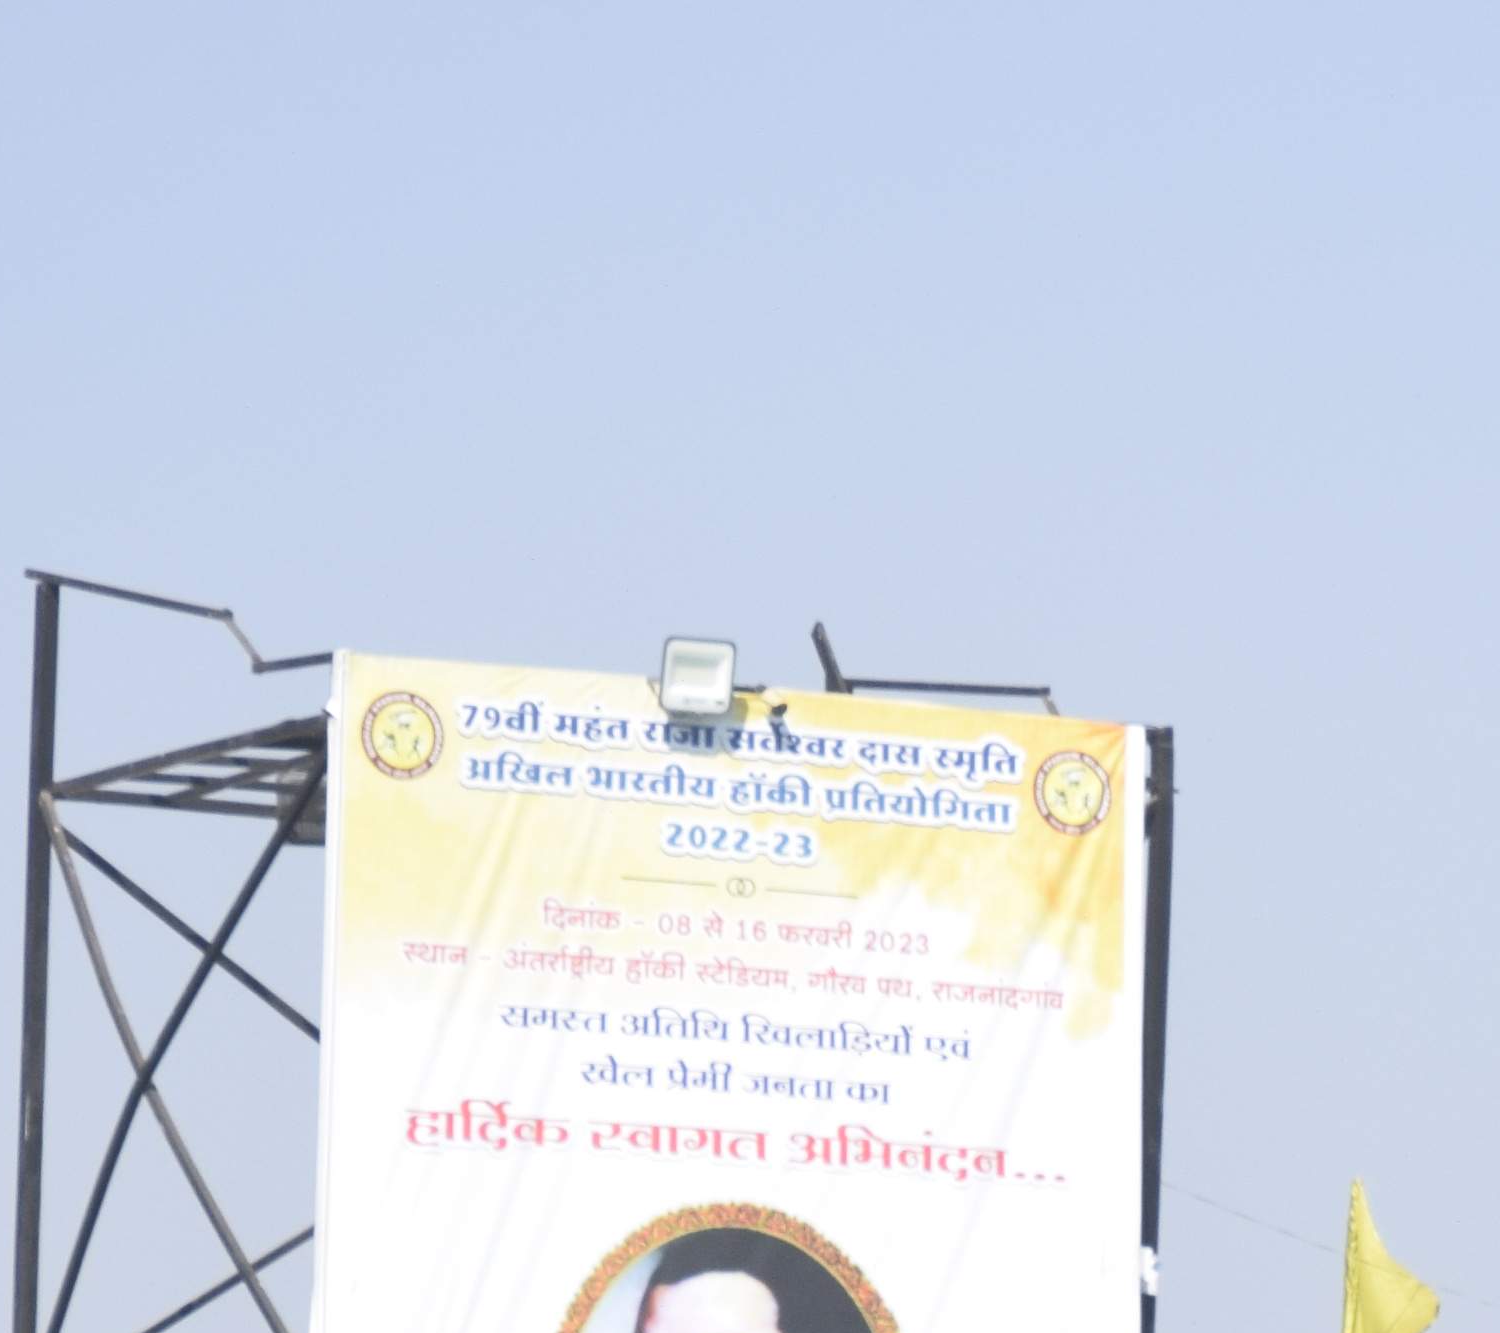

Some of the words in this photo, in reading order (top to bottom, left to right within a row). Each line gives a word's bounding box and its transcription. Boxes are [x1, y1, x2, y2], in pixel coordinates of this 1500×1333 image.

[554, 705, 630, 742] महंत
[642, 720, 716, 750] राजा
[857, 738, 922, 765] दास
[936, 741, 1019, 780] स्मृति
[467, 750, 575, 787] अखिल
[586, 763, 717, 798] भारतीय
[730, 772, 813, 807] हॉकी
[825, 780, 1013, 824] प्रतियोगिता
[665, 823, 813, 858] 2022-23
[543, 897, 621, 931] दिनांक
[657, 913, 691, 935] 08
[703, 911, 724, 938] से
[737, 919, 767, 942] 16
[778, 920, 853, 949] फरवरी
[864, 929, 929, 955] 2023
[403, 942, 468, 964] स्थान
[625, 951, 685, 984] हॉकी
[808, 967, 865, 996] गौरव
[500, 1004, 607, 1034] समस्त
[620, 1006, 727, 1041] अतिथि
[923, 1029, 971, 1061] एवं
[581, 1054, 654, 1087] खेल
[667, 1060, 732, 1092] प्रेमी
[744, 1072, 833, 1101] जनता
[846, 1081, 891, 1104] का
[405, 1099, 569, 1150] हार्दिक
[588, 1120, 767, 1161] स्वागत
